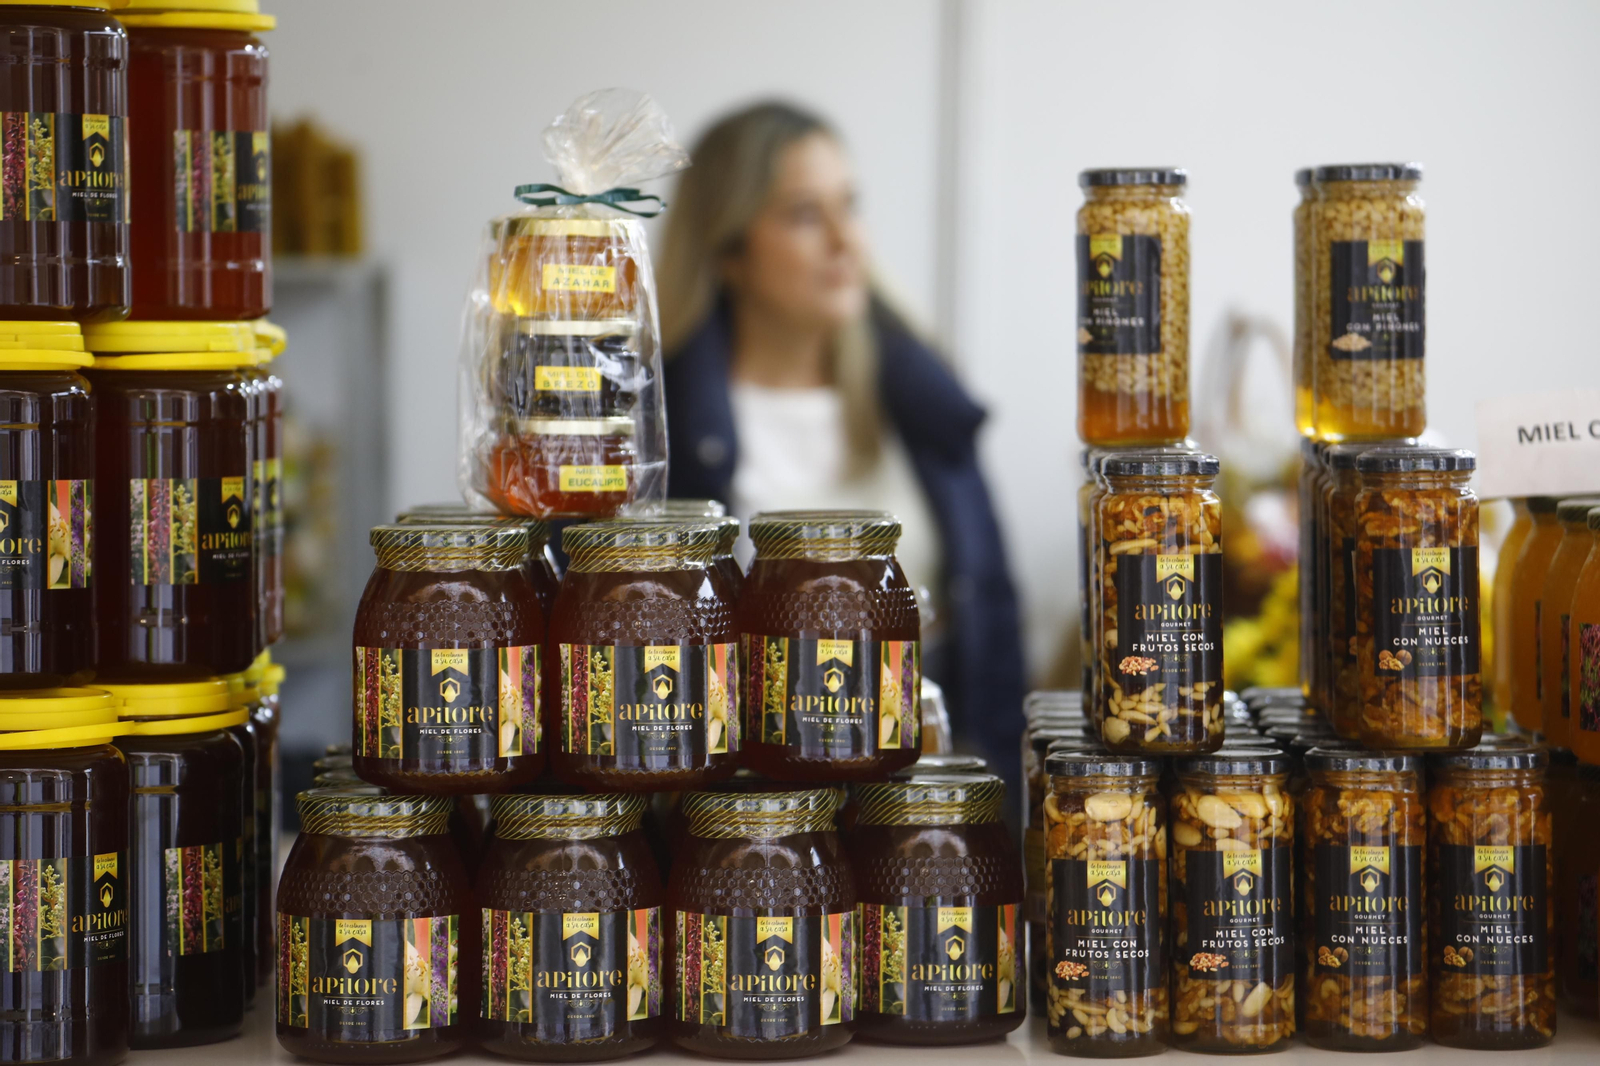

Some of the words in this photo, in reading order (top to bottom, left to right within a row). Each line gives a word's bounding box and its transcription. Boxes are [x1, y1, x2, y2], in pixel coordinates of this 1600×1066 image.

[558, 267, 586, 275] MIEL
[553, 278, 609, 287] AZAHAR
[543, 380, 595, 388] BREZO
[1518, 421, 1581, 445] MIEL
[569, 478, 623, 486] EUCALIPTO
[1419, 627, 1448, 635] MIEL
[1182, 633, 1204, 641] CON
[1425, 636, 1468, 645] NUECES
[1133, 644, 1178, 652] FRUTOS
[1185, 643, 1214, 651] SECOS
[1216, 930, 1245, 938] MIEL
[1252, 928, 1274, 936] CON
[1356, 926, 1385, 934] MIEL
[1202, 940, 1248, 948] FRUTOS
[1255, 936, 1284, 947] SECOS
[1331, 935, 1354, 943] CON
[1362, 936, 1407, 944] NUECES
[1456, 934, 1479, 943] CON
[1487, 935, 1533, 943] NUECES
[1078, 940, 1106, 948] MIEL
[1113, 940, 1137, 948] CON
[1066, 949, 1109, 958] FRUTOS
[1116, 949, 1149, 958] SECOS
